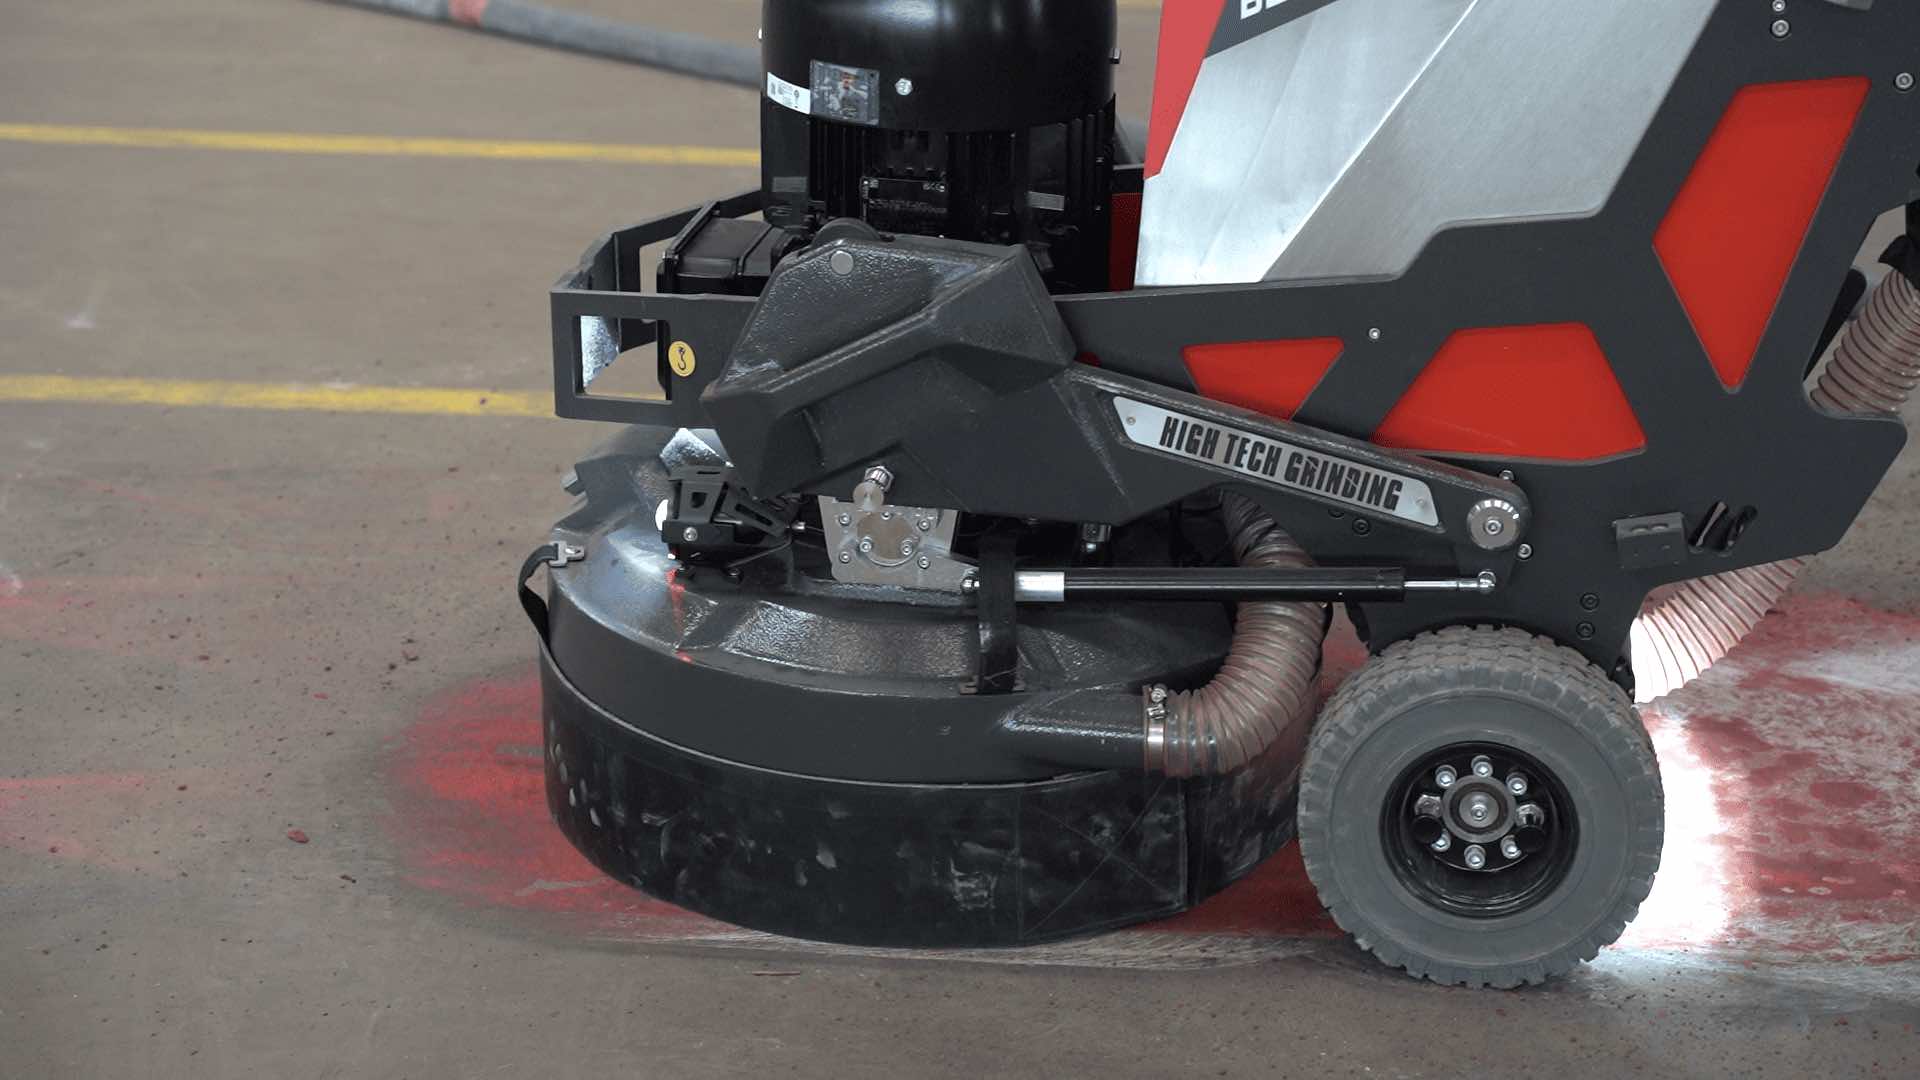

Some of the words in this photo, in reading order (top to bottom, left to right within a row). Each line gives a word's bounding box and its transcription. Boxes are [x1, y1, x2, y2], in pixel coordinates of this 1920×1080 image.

[1160, 416, 1222, 459] HIGH
[1224, 434, 1284, 477] TECH
[1285, 453, 1403, 511] GRINDING
